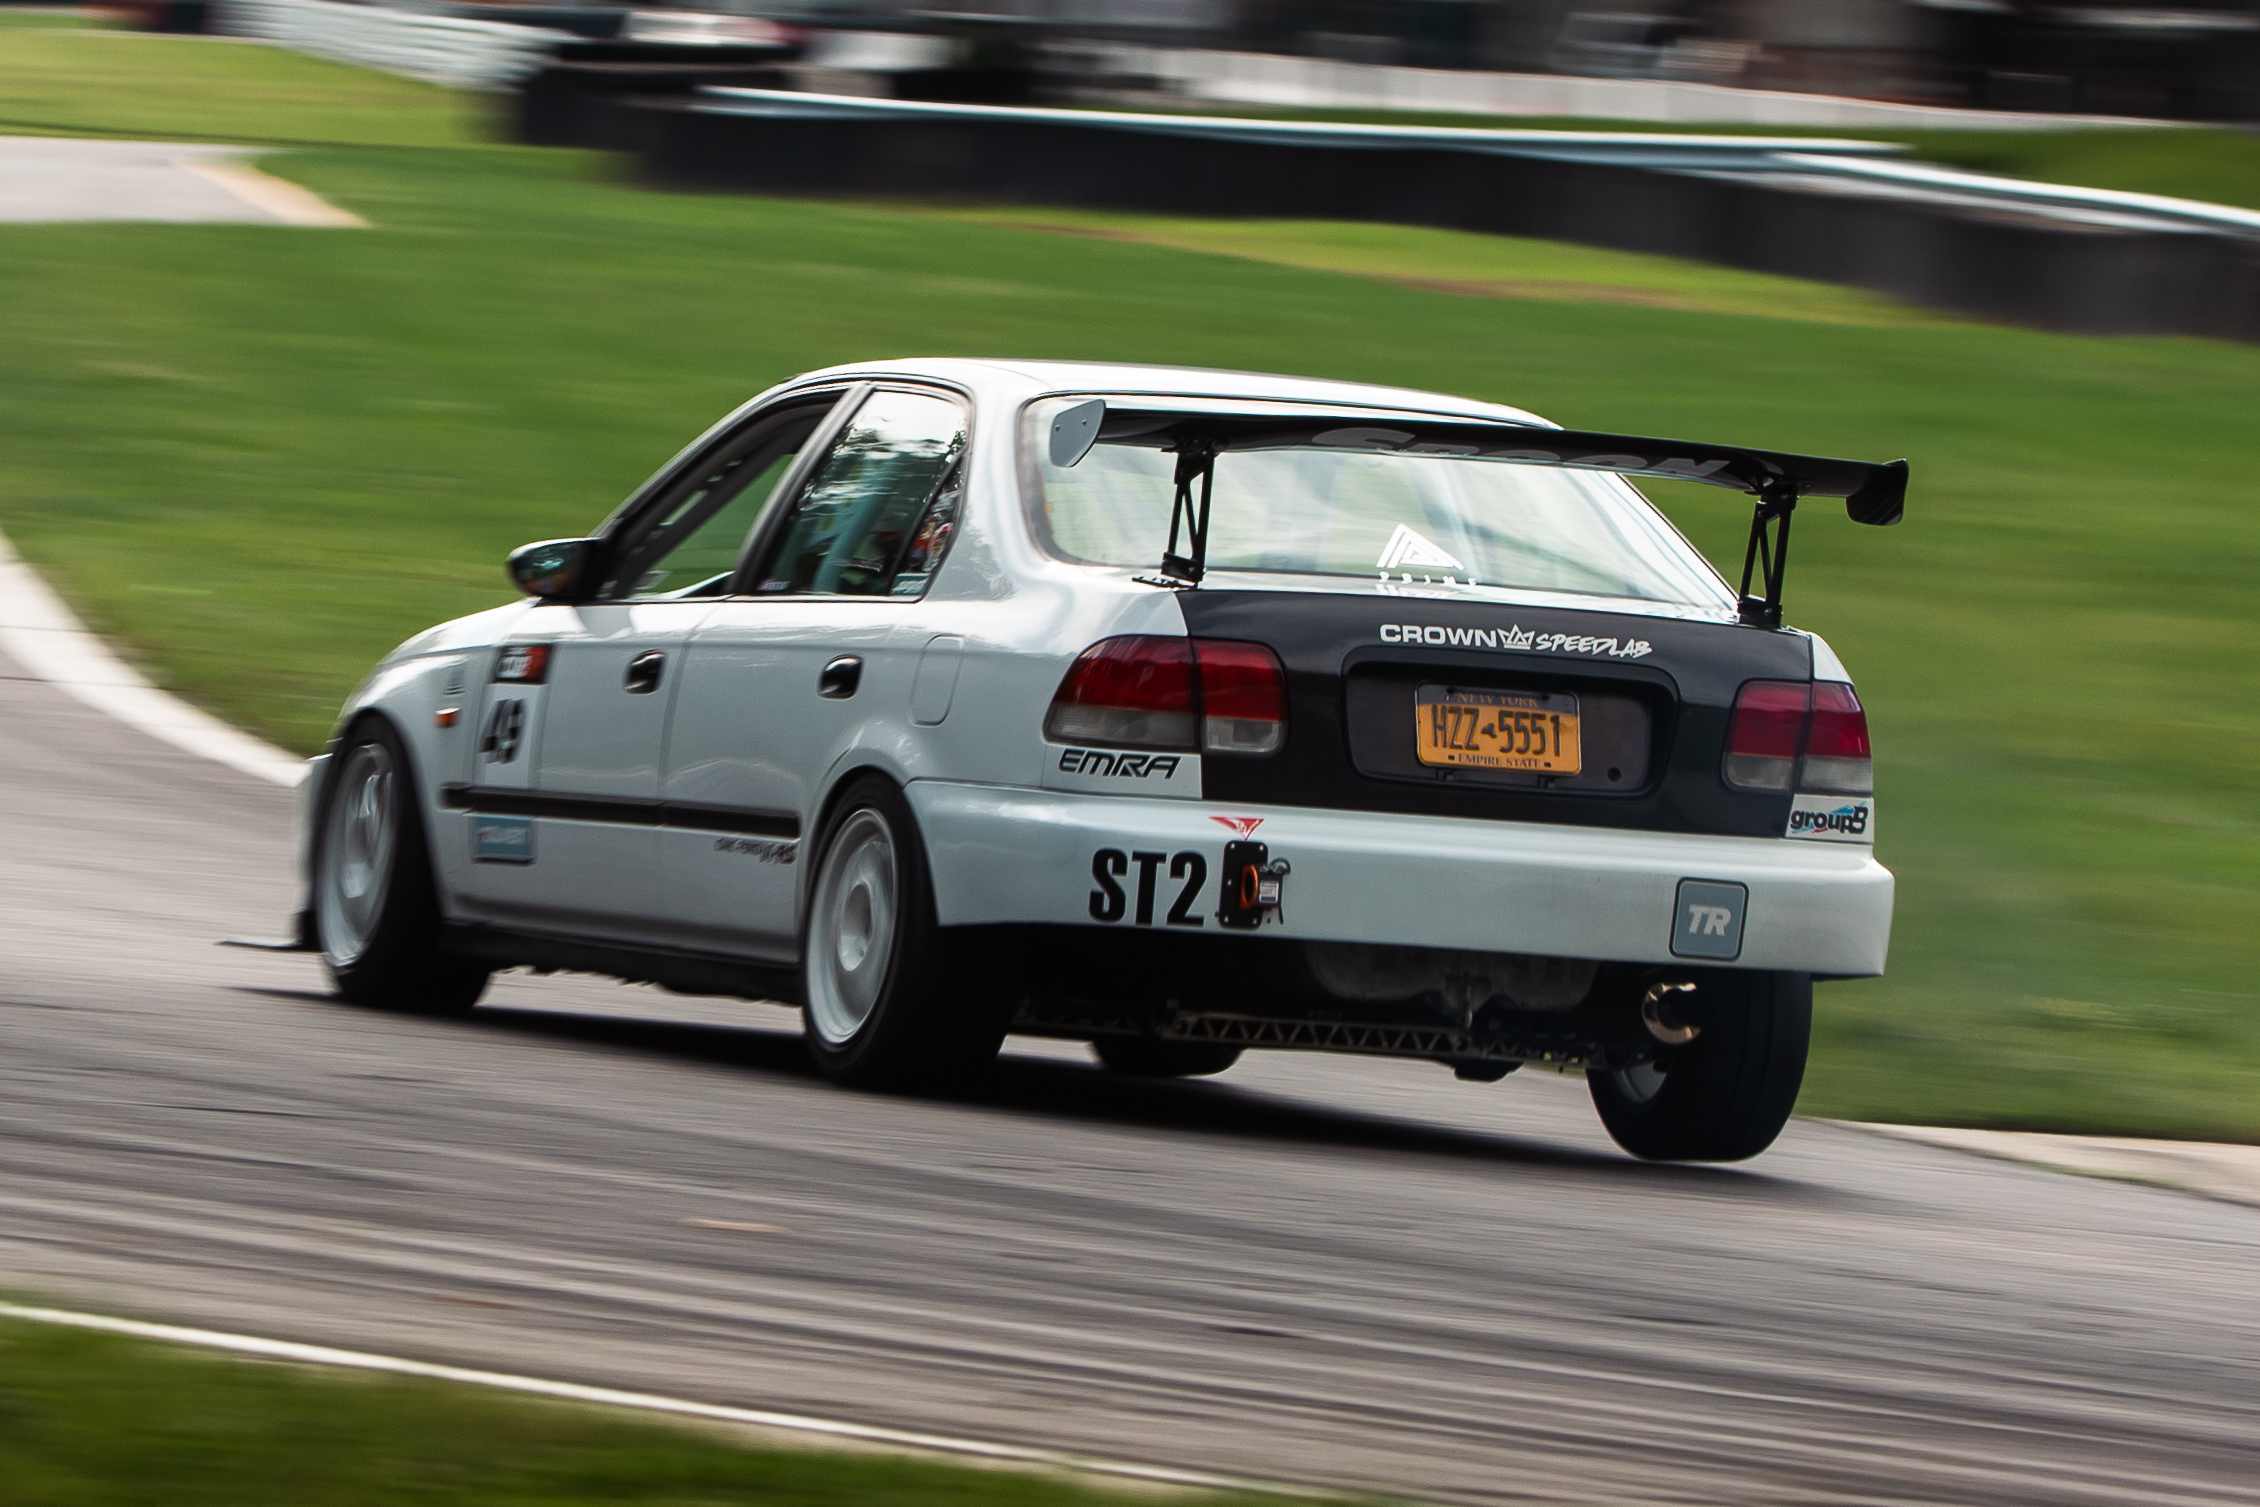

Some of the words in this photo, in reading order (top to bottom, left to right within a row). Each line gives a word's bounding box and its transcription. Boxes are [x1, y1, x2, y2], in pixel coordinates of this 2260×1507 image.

[1379, 624, 1497, 648] CROWN
[1535, 633, 1653, 658] SPEEDLAB
[1431, 704, 1480, 750] HZZ
[1498, 710, 1561, 757] 5551
[1058, 748, 1181, 779] EMRA
[1457, 753, 1500, 766] EMPIRE
[1506, 758, 1540, 769] STATE
[1089, 848, 1207, 928] ST2
[1689, 905, 1731, 936] TR
